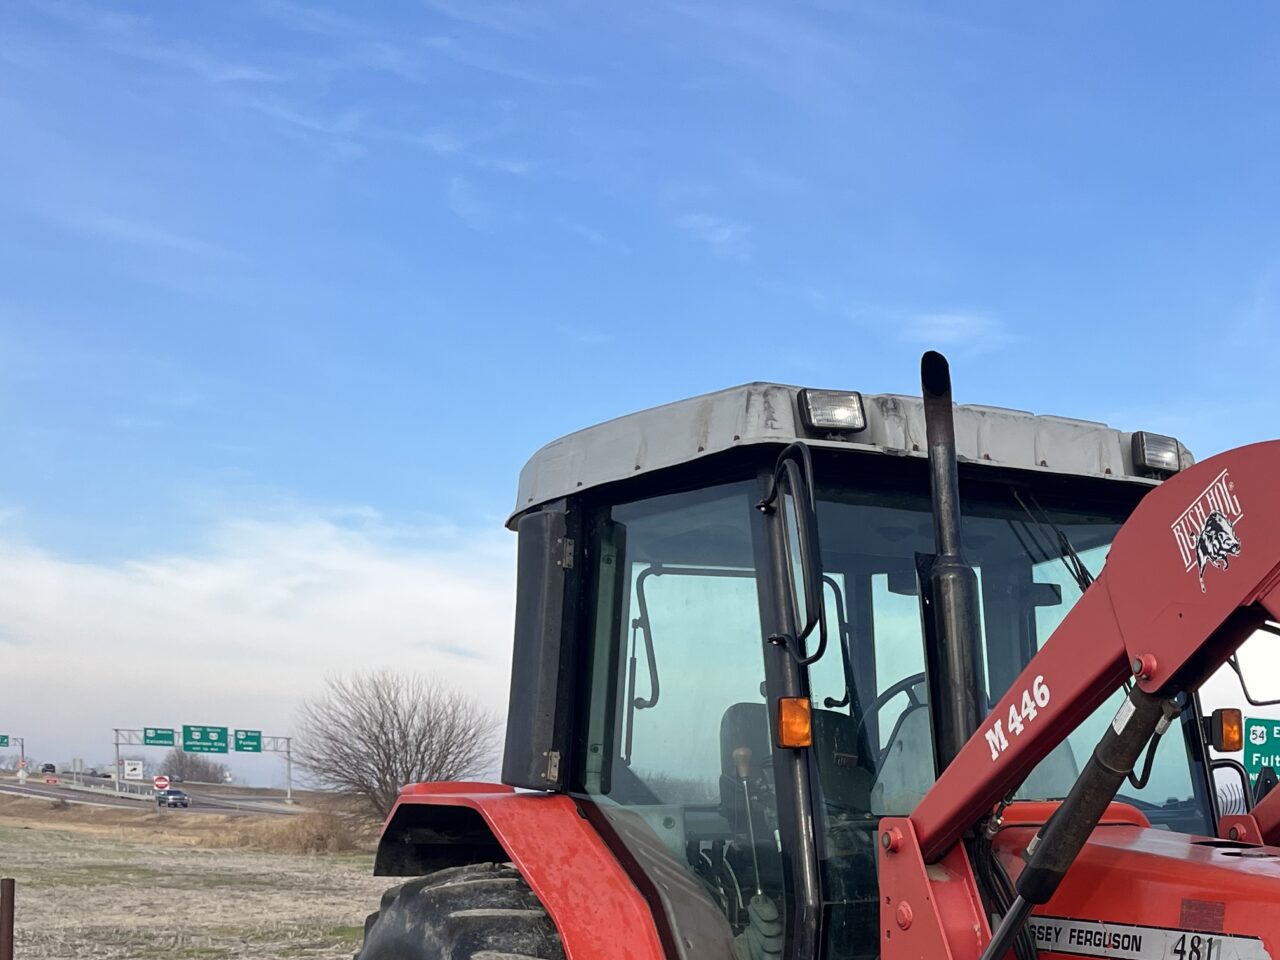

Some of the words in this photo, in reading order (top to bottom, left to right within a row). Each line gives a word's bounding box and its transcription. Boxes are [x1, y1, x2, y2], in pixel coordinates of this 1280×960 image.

[985, 718, 1009, 761] M
[1008, 675, 1050, 736] 446
[1251, 729, 1265, 741] 54
[1068, 928, 1142, 952] FERGUSON
